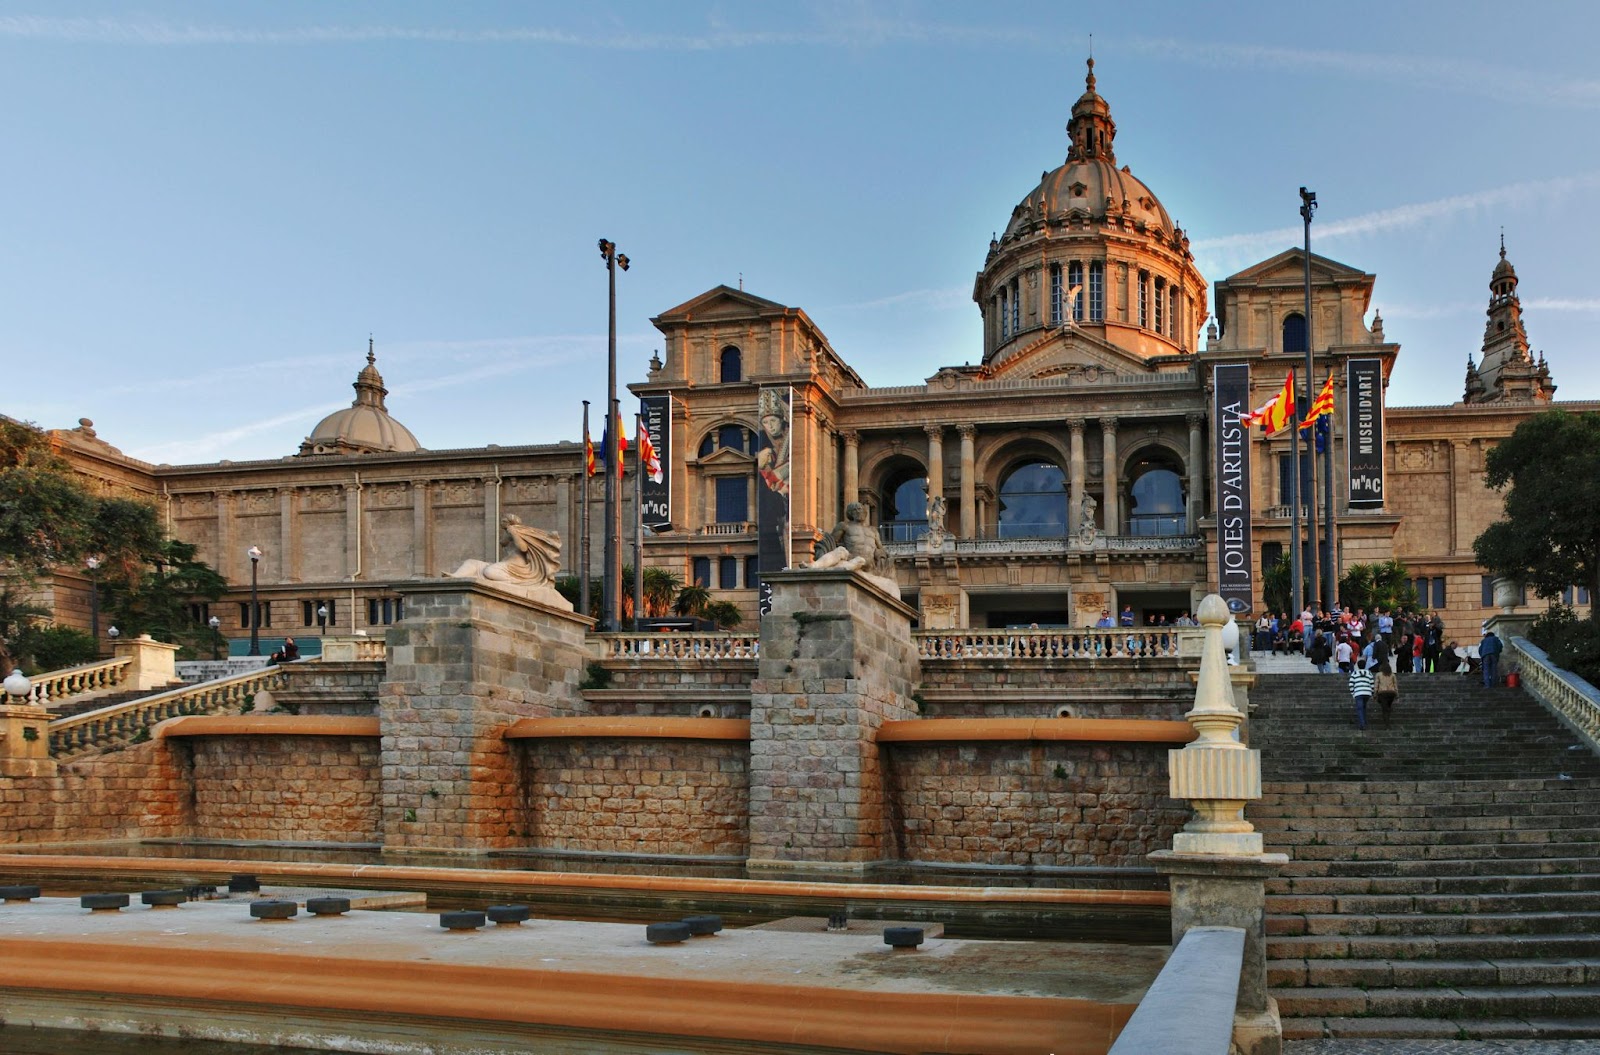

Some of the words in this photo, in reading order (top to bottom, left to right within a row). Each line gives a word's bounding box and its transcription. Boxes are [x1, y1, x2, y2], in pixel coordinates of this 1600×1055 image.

[1359, 375, 1372, 408] D'ART
[1359, 414, 1373, 454] MUSEU
[1353, 475, 1381, 493] MNAC
[641, 500, 668, 518] MNAC
[1224, 517, 1249, 579] JOIES
